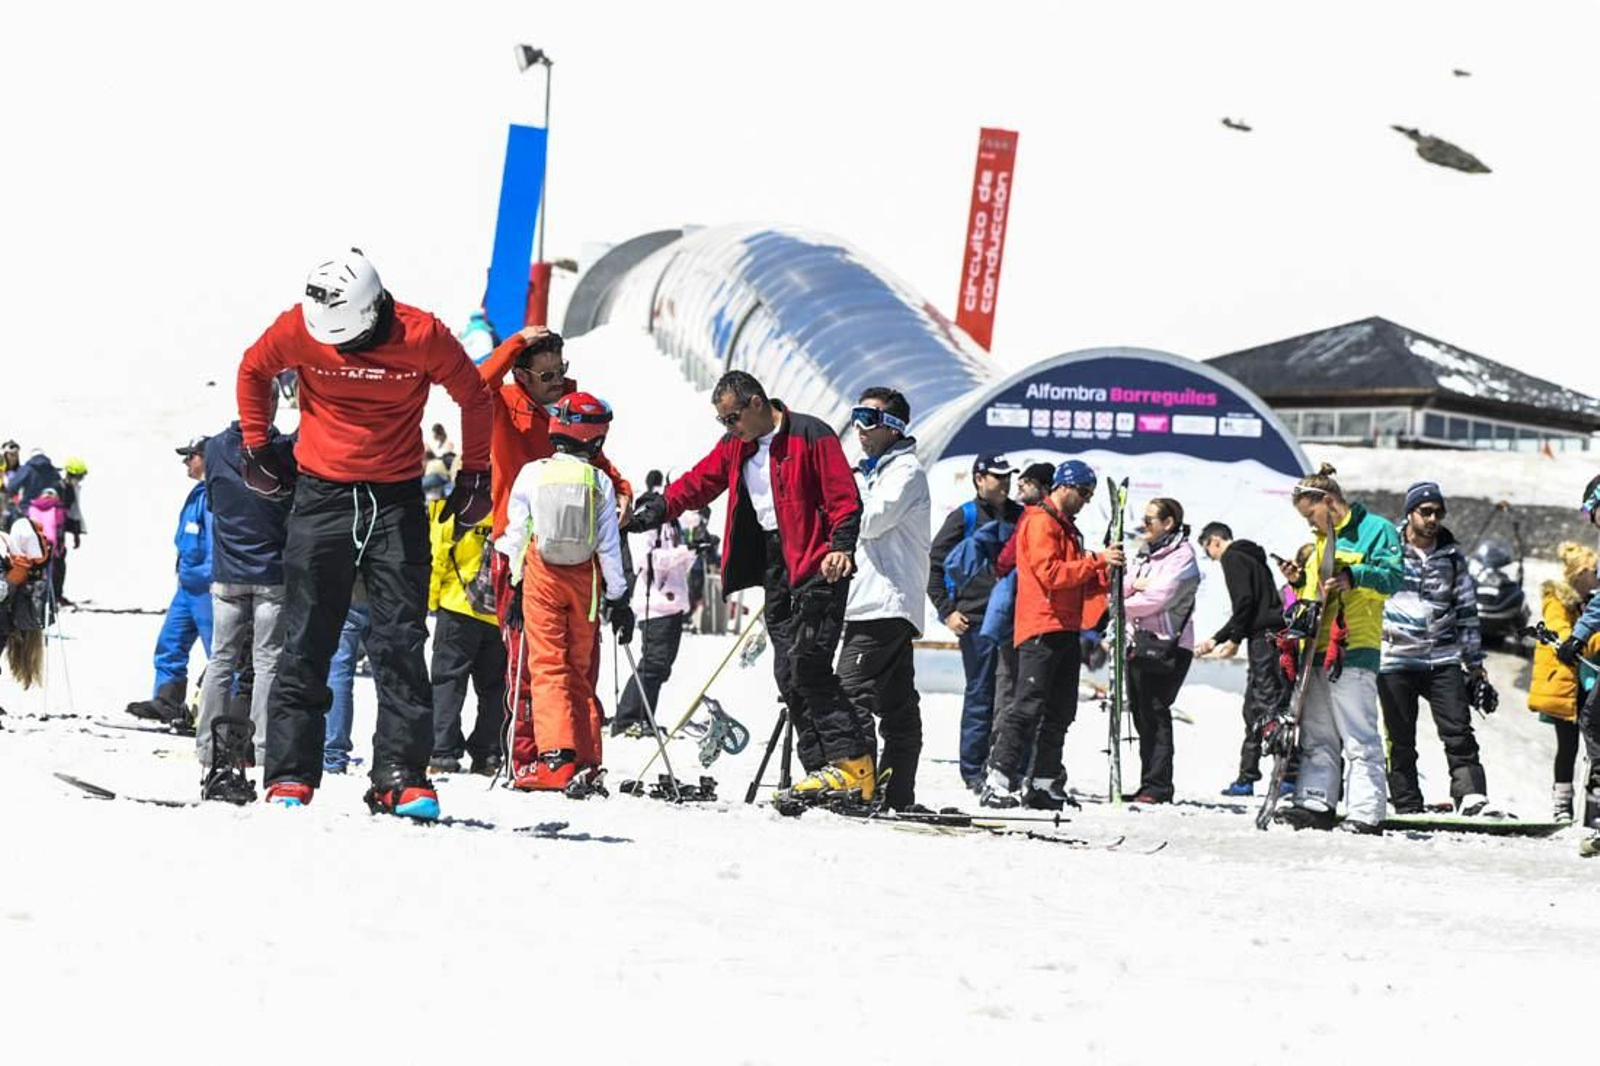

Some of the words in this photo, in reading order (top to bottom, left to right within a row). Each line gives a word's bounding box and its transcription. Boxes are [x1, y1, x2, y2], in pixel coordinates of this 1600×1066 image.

[964, 211, 988, 312] circuito
[978, 169, 993, 203] de
[980, 171, 1009, 314] conducción
[1026, 383, 1107, 402] Alfombra
[1110, 387, 1217, 406] Borreguiles
